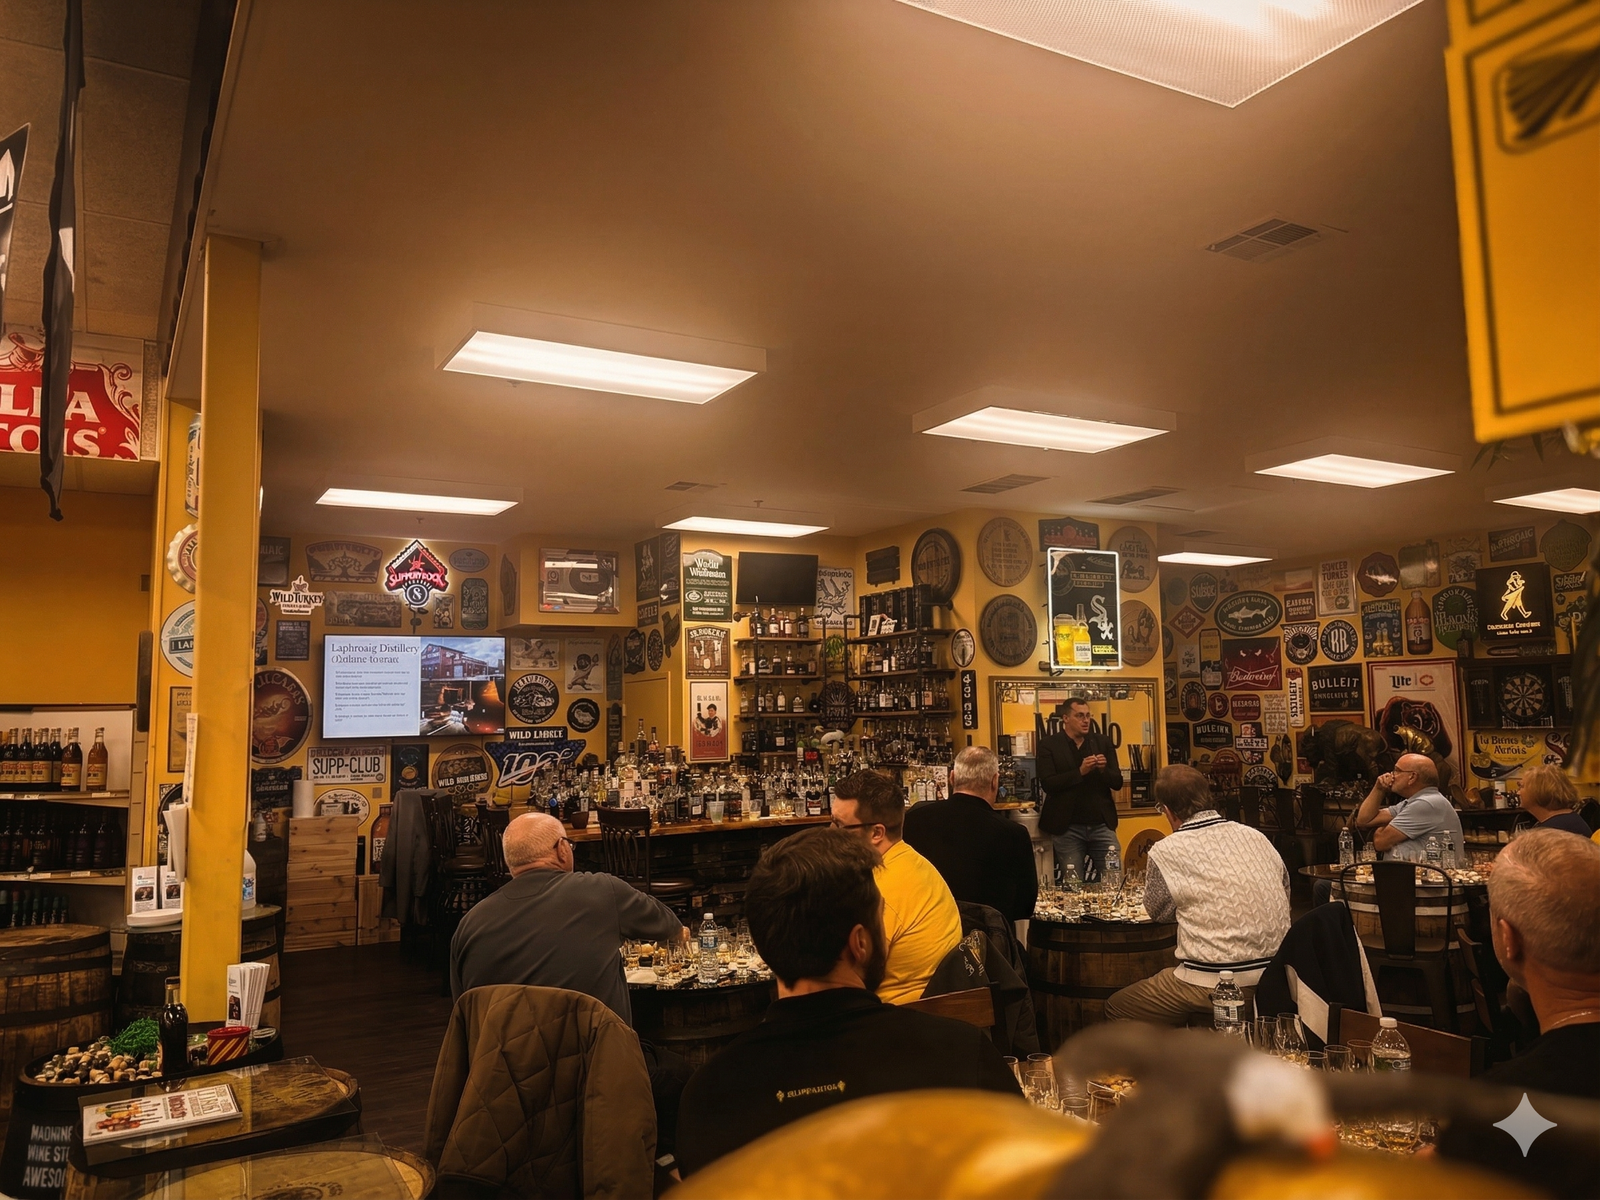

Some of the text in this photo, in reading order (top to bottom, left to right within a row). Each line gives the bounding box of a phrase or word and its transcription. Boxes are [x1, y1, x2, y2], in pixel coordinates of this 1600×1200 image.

[272, 592, 294, 603] WILD
[331, 643, 420, 655] Laphroaig Distillery
[1311, 676, 1361, 692] BULLEIT
[1389, 675, 1412, 689] Lite
[509, 730, 532, 740] WILD
[312, 757, 381, 775] SUPP-CLUB
